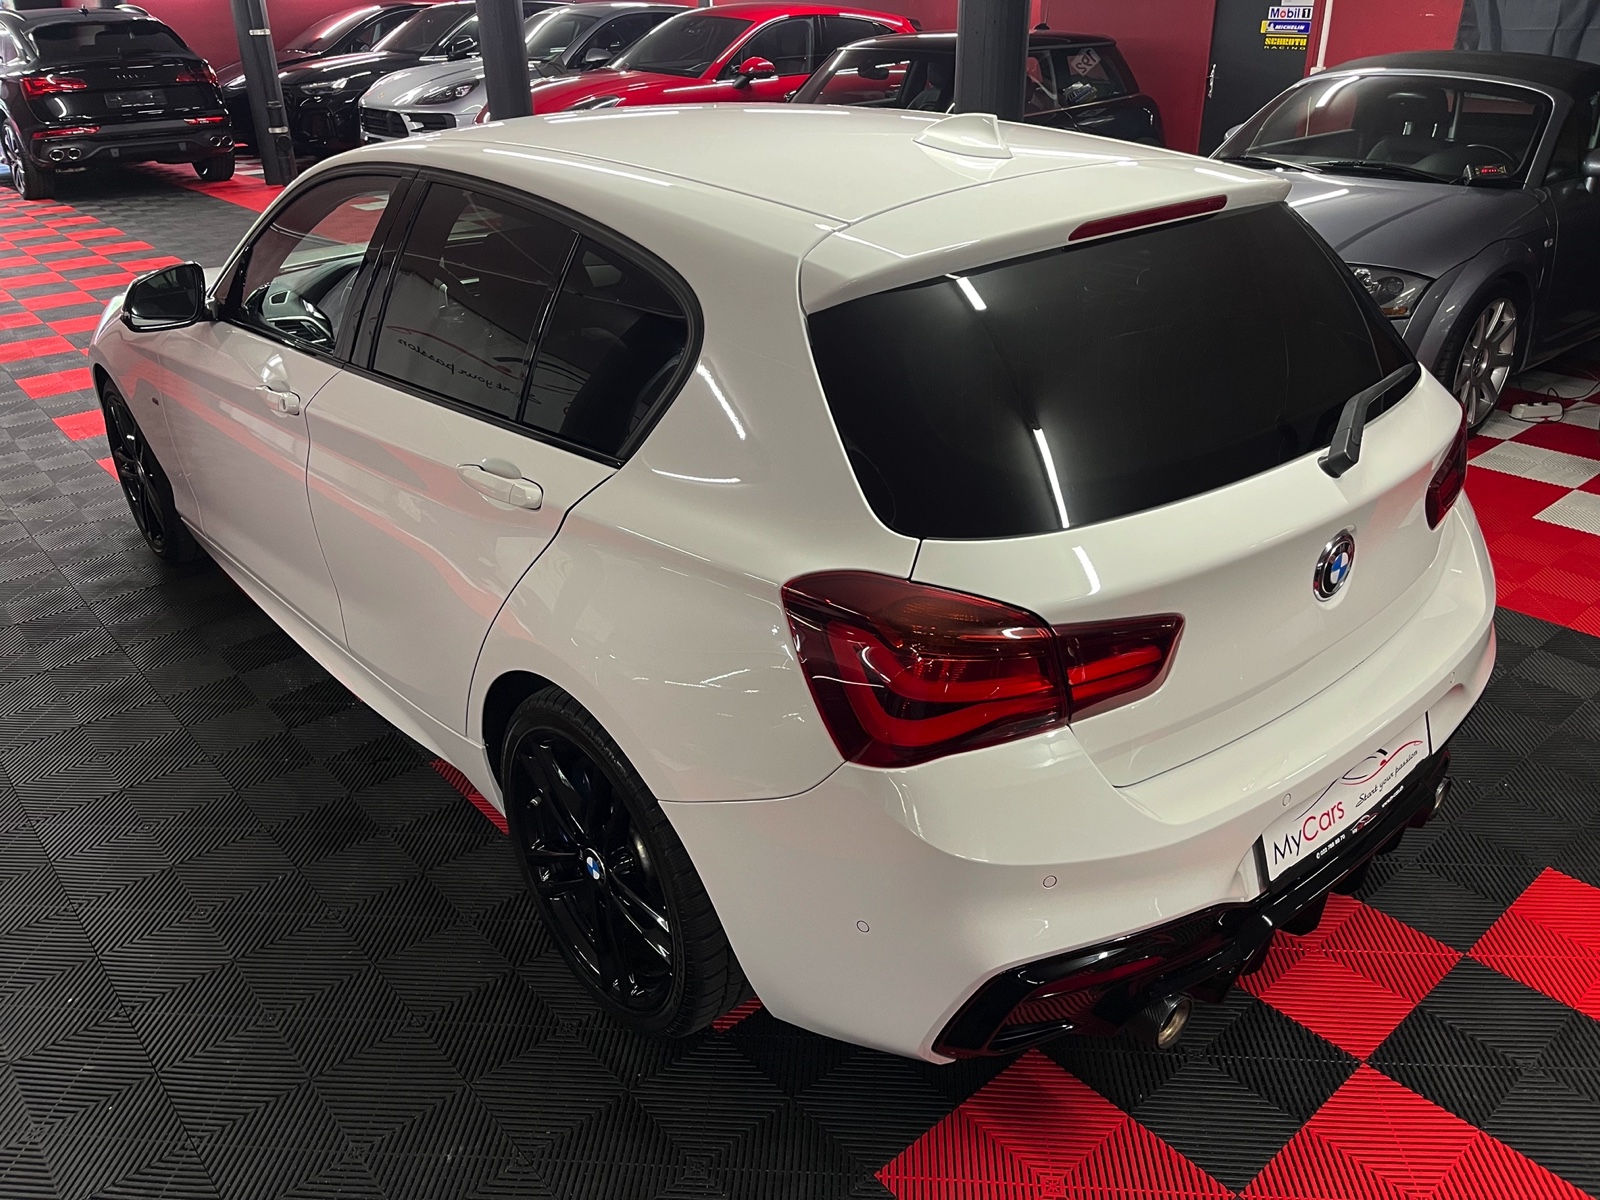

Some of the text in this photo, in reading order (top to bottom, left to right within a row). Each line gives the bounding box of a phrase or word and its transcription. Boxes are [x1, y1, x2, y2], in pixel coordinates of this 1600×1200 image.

[1270, 8, 1300, 18] Mobil
[1265, 37, 1307, 46] SCHROTH
[1355, 785, 1378, 808] Start
[1379, 772, 1394, 792] your
[1395, 750, 1418, 778] passion
[1273, 801, 1345, 865] MyCars
